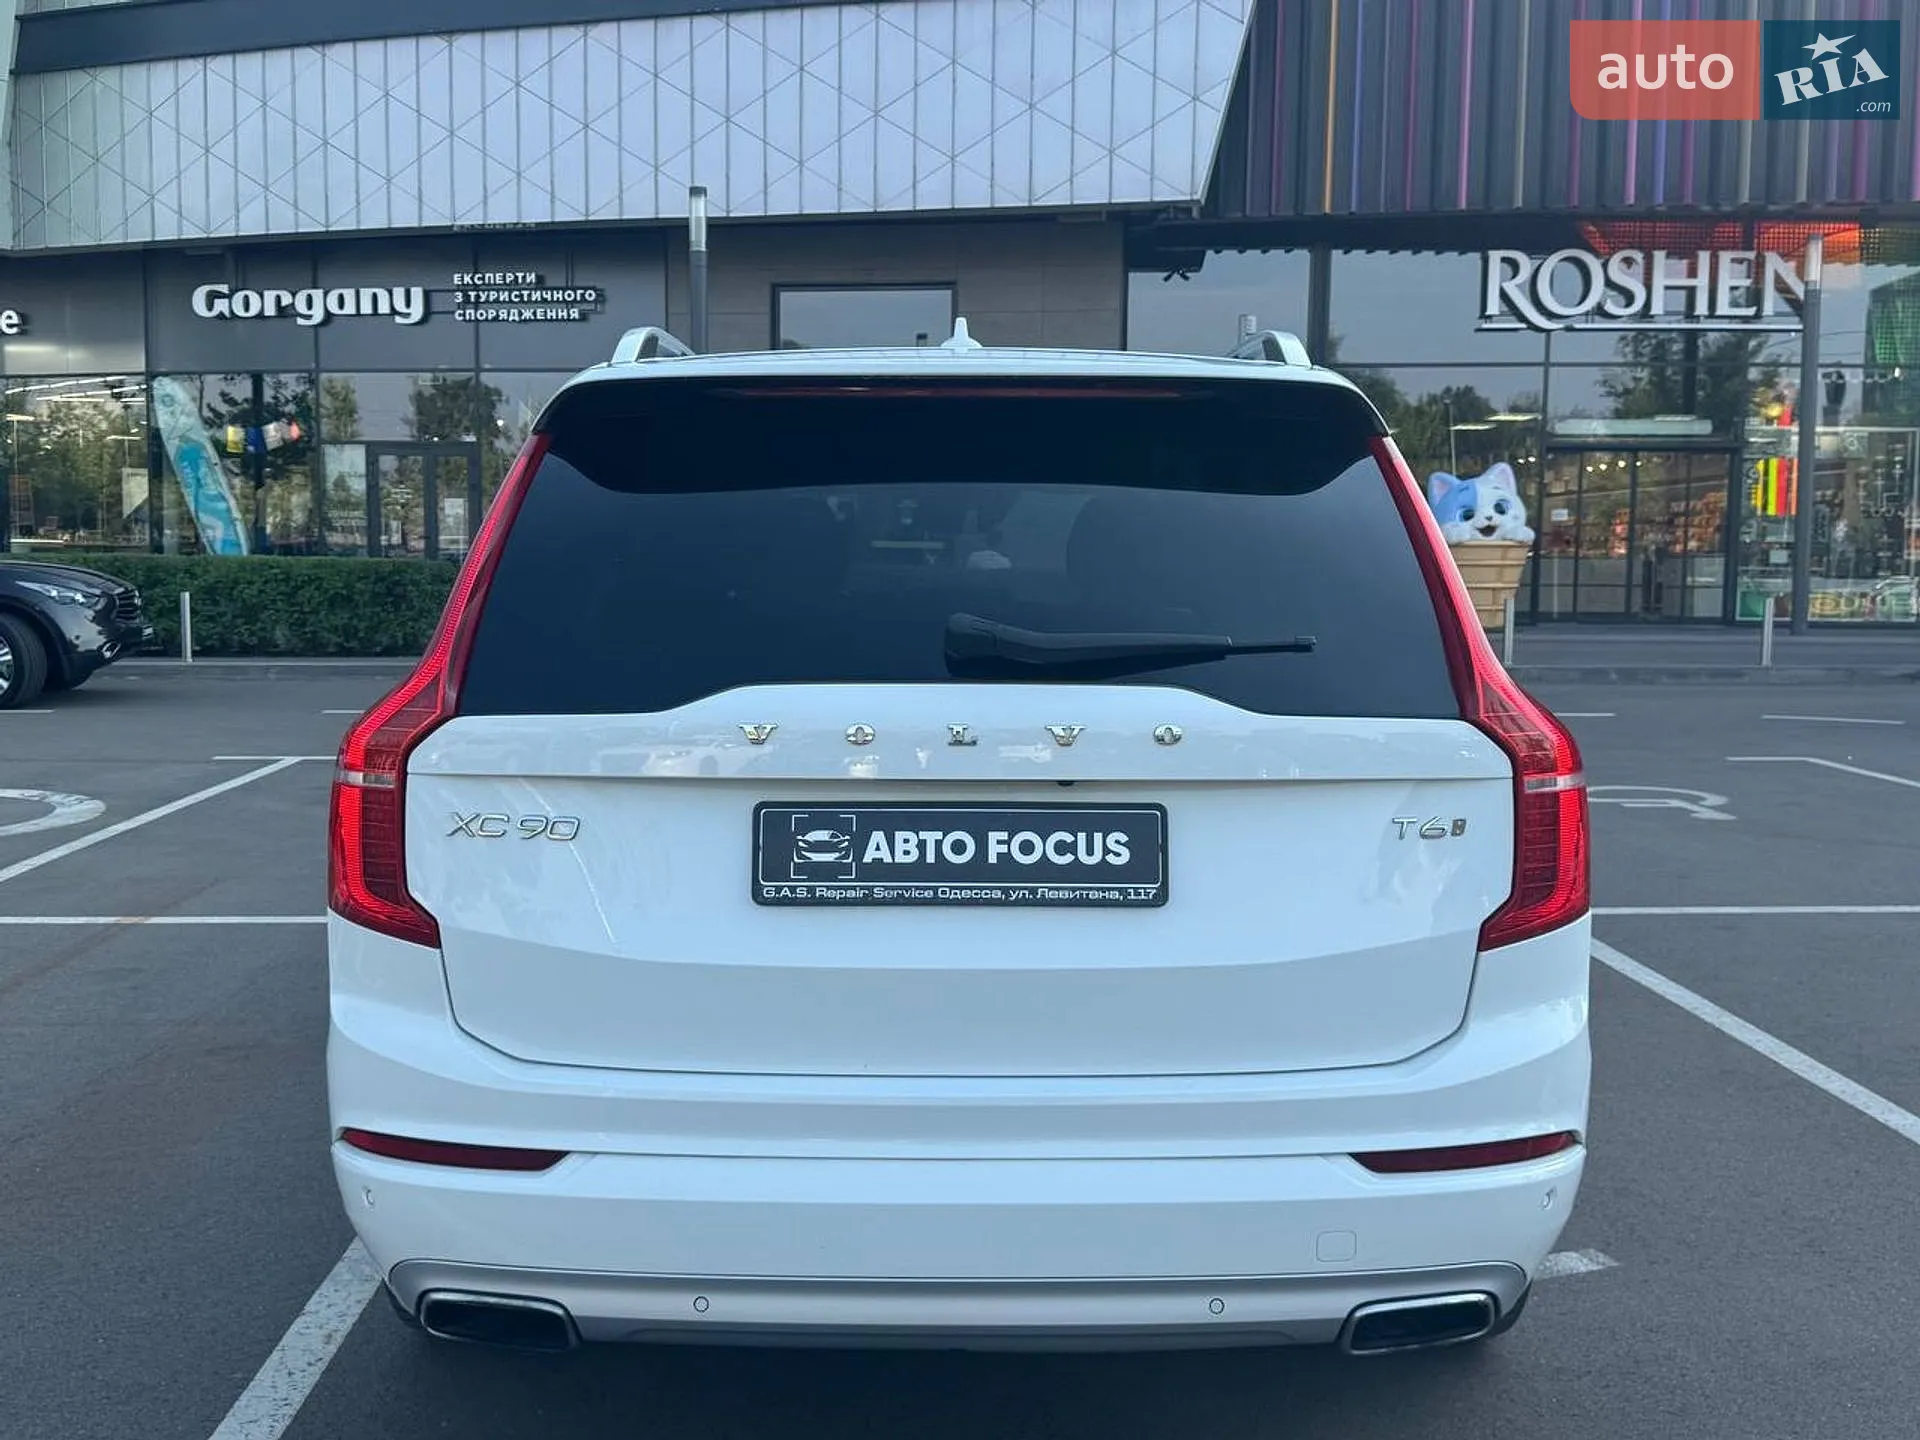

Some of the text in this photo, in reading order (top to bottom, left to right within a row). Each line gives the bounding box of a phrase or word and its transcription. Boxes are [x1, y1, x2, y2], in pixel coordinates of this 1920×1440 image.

[453, 272, 537, 285] ЕКСПЕРТИ
[469, 289, 597, 302] ТУРИСТИЧНОГО
[1485, 248, 1805, 331] ROSHEN
[191, 284, 424, 326] Gorgany
[454, 308, 580, 322] СПОРЯДЖЕННЯ
[737, 723, 1184, 746] VOLVO
[987, 831, 1131, 866] FOCUS
[763, 887, 812, 898] G.A.S.
[816, 887, 869, 900] Repair
[873, 887, 934, 898] Service
[938, 888, 1006, 900] Одесса,
[1008, 889, 1034, 901] ул.
[1127, 888, 1157, 900] 117
